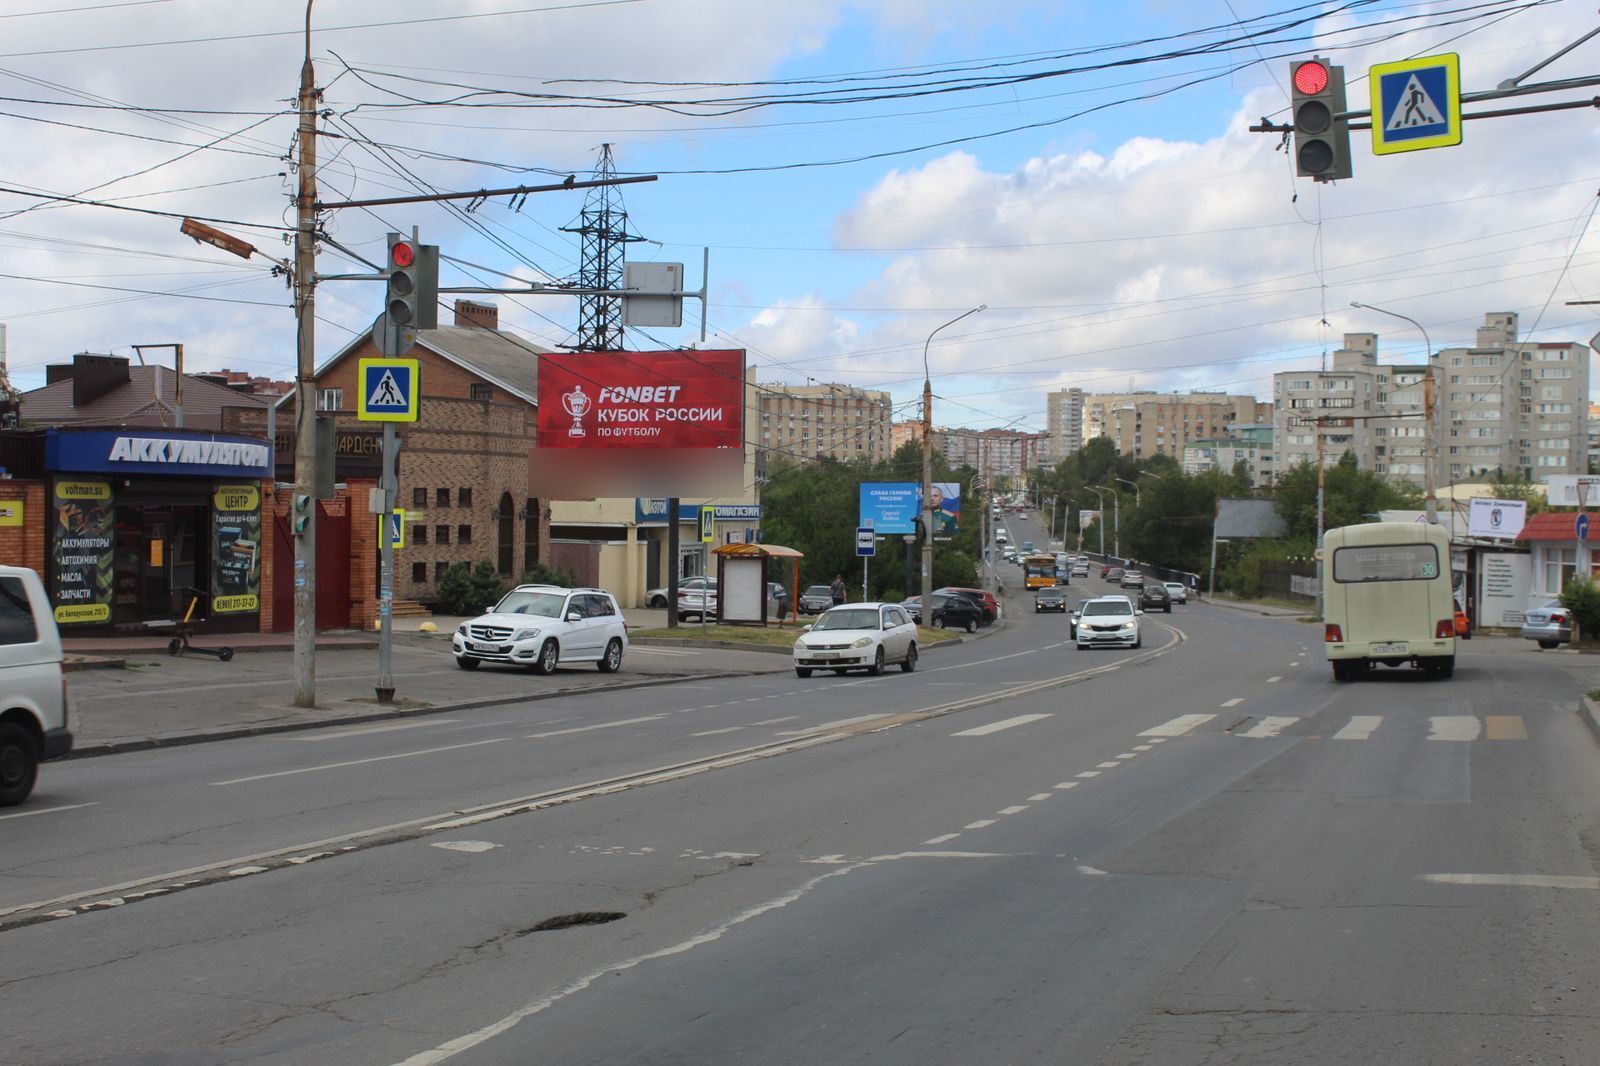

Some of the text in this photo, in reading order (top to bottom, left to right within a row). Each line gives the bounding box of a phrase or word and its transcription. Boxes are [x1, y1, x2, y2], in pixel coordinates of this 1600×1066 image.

[598, 385, 681, 403] FONBET
[598, 407, 723, 422] КУБОК РОССИИ
[597, 427, 661, 436] ПО ФУТБОЛУ
[64, 484, 103, 495] voltman.su
[225, 495, 249, 509] ЦЕНТР
[62, 538, 109, 548] АККУМУЛЯТОРЫ
[61, 555, 98, 565] АВТОХИМИЯ
[61, 572, 82, 582] МАСЛА
[60, 589, 91, 599] ЗАПЧАСТИ
